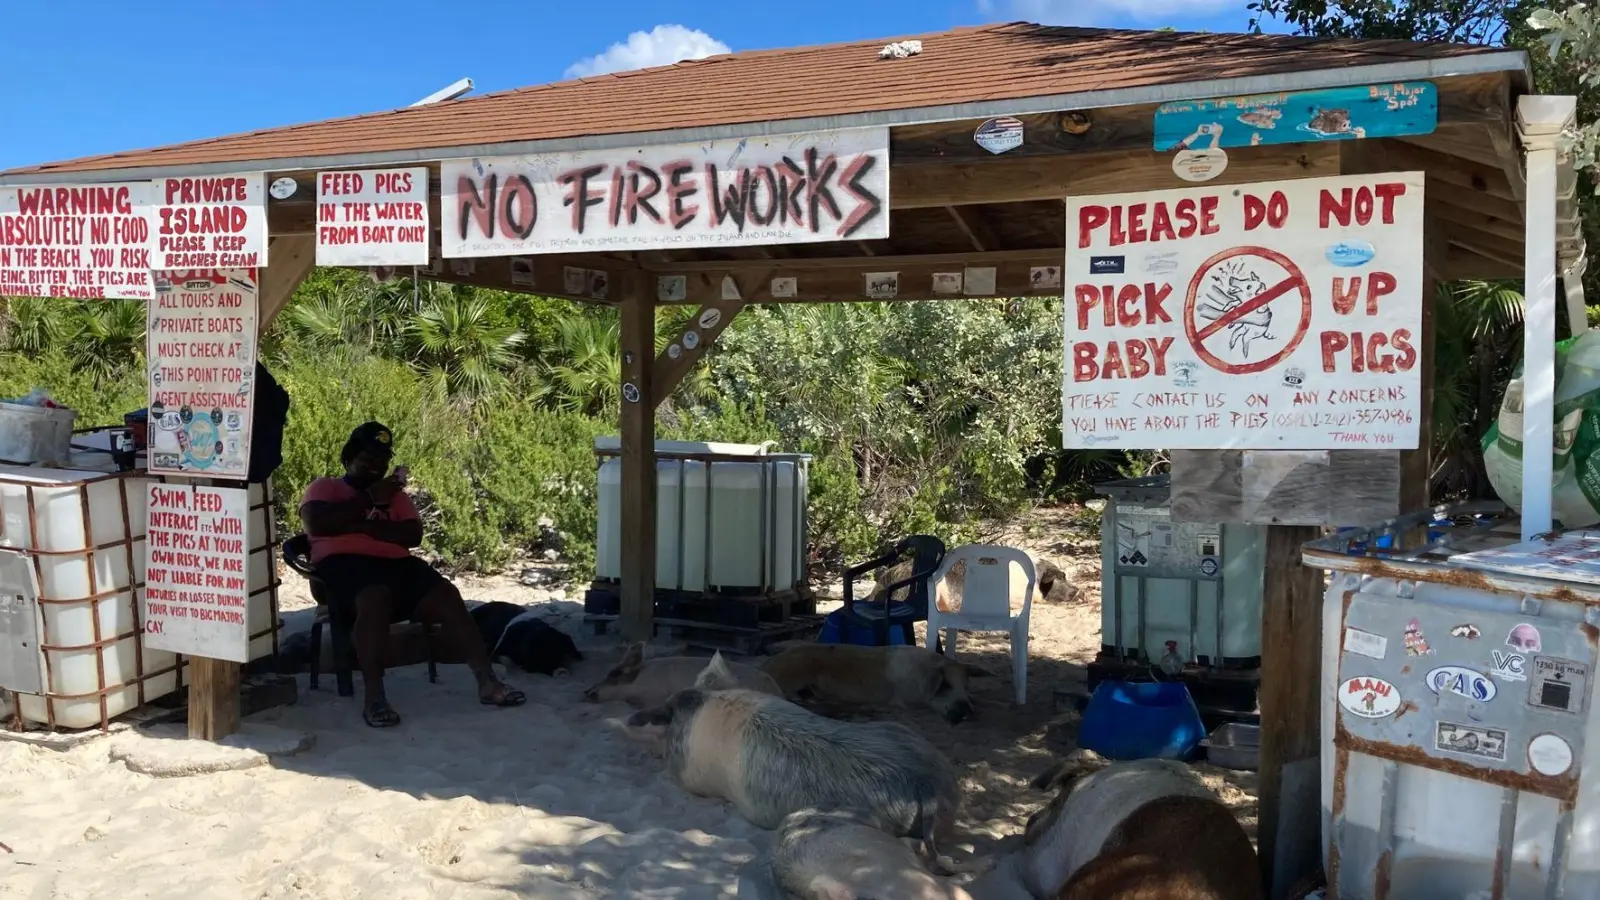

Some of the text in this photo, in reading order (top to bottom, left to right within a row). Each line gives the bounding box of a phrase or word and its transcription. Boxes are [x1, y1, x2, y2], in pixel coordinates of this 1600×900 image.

[1386, 96, 1417, 110] Spot
[165, 178, 247, 205] PRIVATE
[322, 172, 412, 196] FEED PIGS
[458, 146, 881, 240] NO FIREWORKS
[18, 186, 132, 216] WARNING
[159, 205, 248, 235] ISLAND
[320, 202, 424, 222] IN THE WATER
[1079, 183, 1406, 248] PLEASE DO NOT
[90, 216, 110, 244] NO
[114, 216, 148, 244] FOOD
[320, 226, 426, 245] FROM BOAT ONLY
[160, 235, 247, 252] PLEASE KEEP
[0, 248, 11, 267] N
[15, 248, 38, 268] THE
[41, 248, 80, 268] BEACH
[121, 248, 150, 268] RISK
[165, 252, 258, 267] BEACHES CLEAN
[0, 270, 26, 284] EING
[29, 270, 66, 284] BITTEN
[98, 270, 124, 285] PIGS
[126, 272, 148, 286] ARE
[50, 285, 104, 298] BEWARE
[159, 293, 242, 308] ALL TOURS AND
[1075, 272, 1398, 330] PICK UP
[161, 318, 243, 333] PRIVATE BOATS
[158, 343, 242, 358] MUST CHECK AT
[1073, 328, 1417, 382] BABY PIGS
[161, 368, 242, 382] THIS POINT FOR
[155, 392, 246, 408] AGENT ASSISTANCE
[1205, 392, 1226, 408] US
[1245, 394, 1268, 407] ON
[1293, 390, 1319, 407] ANY
[1328, 386, 1407, 405] CONCERNS
[1071, 416, 1096, 434] YOU
[1106, 416, 1137, 432] HAVE
[1144, 415, 1189, 431] ABOUT
[1196, 413, 1220, 430] THE
[1230, 411, 1268, 429] PIGS
[1328, 432, 1394, 443] THANK YOU
[150, 512, 198, 531] INTERACT
[212, 518, 242, 535] WITH
[149, 530, 243, 554] THE PIGS AT YOUR
[152, 550, 174, 565] OWN
[205, 556, 220, 570] WE
[223, 559, 243, 572] ARE
[148, 568, 245, 590] NOT LIABLE FOR ANY
[146, 588, 245, 608] INJURIES OR LOSSES DURING
[148, 602, 168, 616] YOUR
[170, 605, 187, 617] VISIT
[190, 607, 199, 619] TO
[1493, 651, 1524, 672] VC
[1555, 664, 1565, 674] kg
[1567, 667, 1585, 676] max
[1434, 671, 1488, 700] CAS
